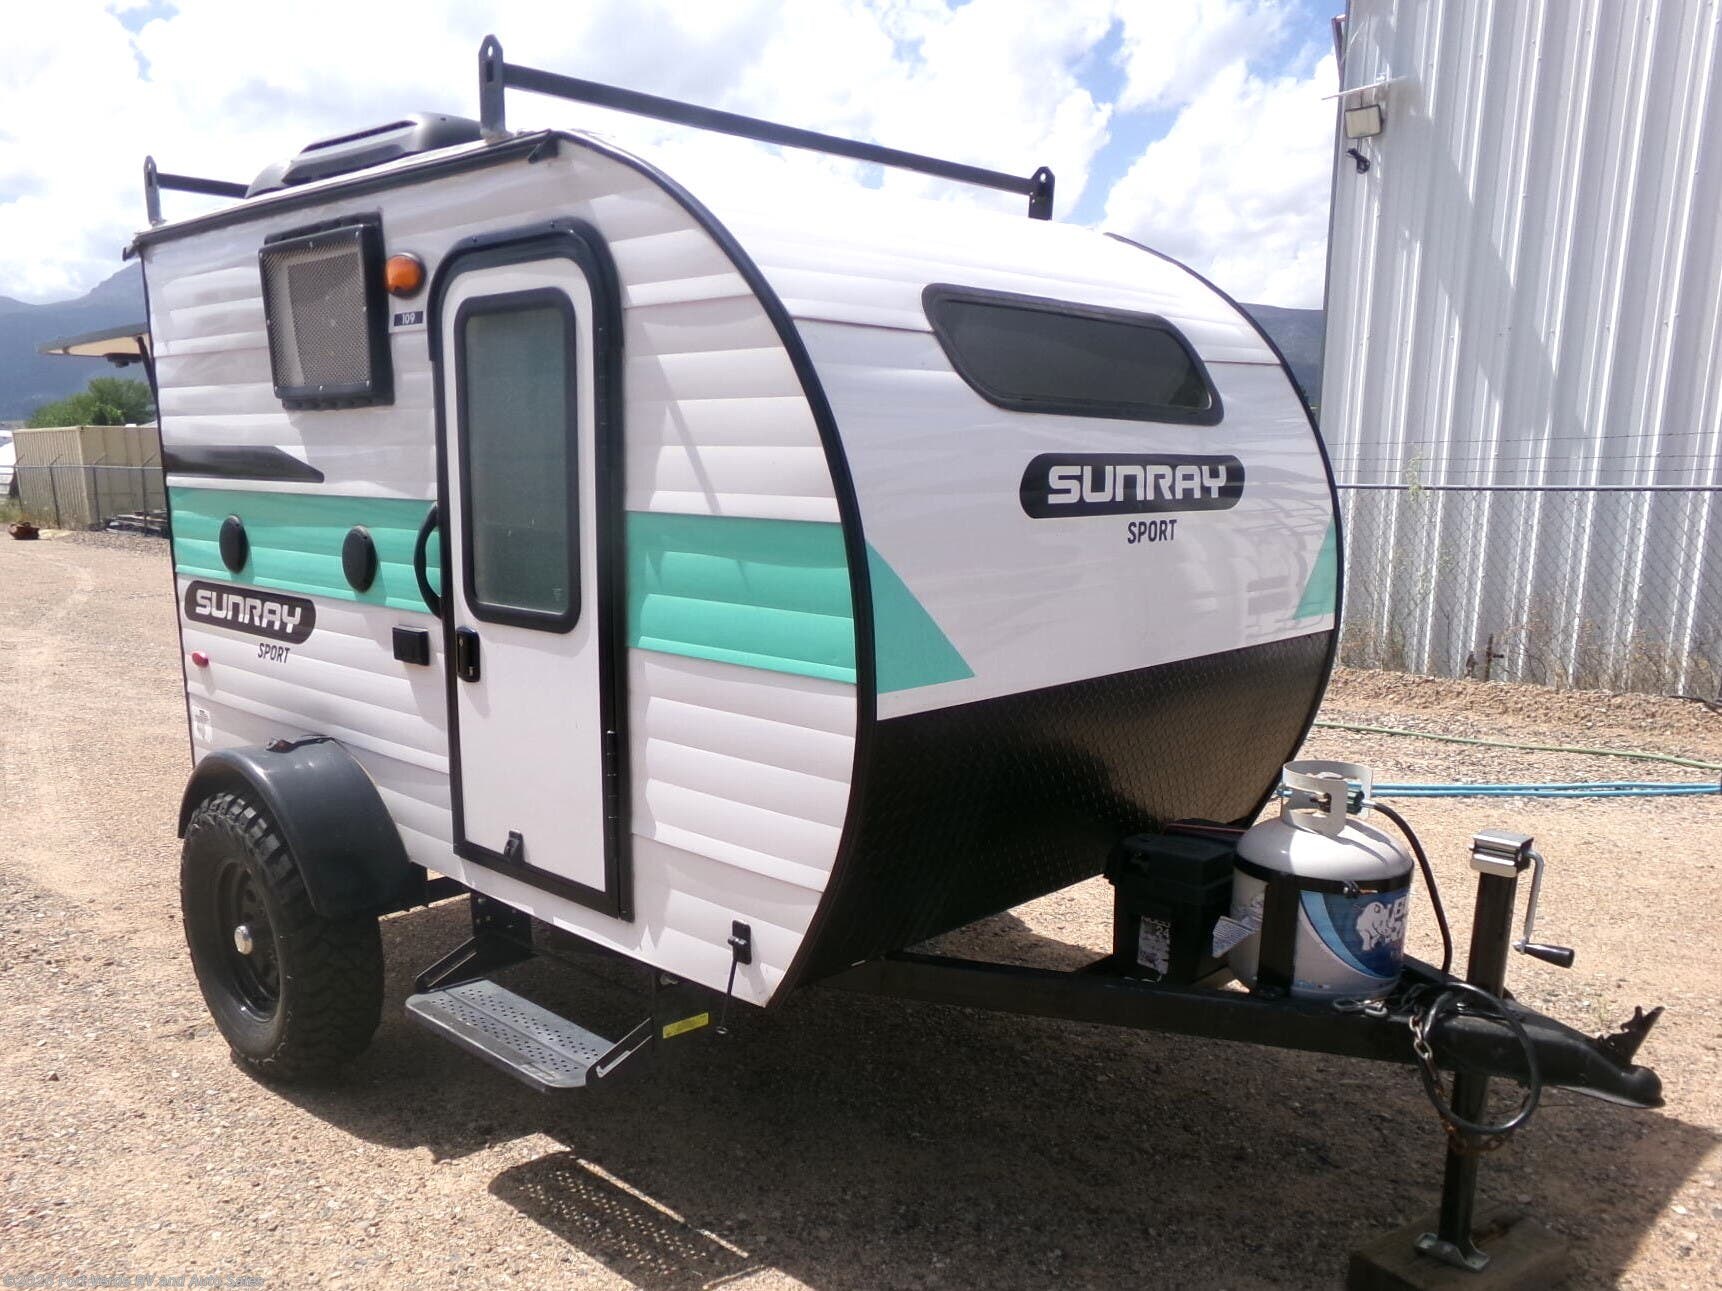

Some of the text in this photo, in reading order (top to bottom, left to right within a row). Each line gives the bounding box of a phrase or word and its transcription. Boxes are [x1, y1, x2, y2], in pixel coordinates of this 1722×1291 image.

[402, 312, 416, 325] 109
[1047, 465, 1227, 505] SUNRAY
[1127, 519, 1177, 545] SPORT
[195, 589, 302, 634] SUNRAY
[257, 642, 291, 664] SPORT
